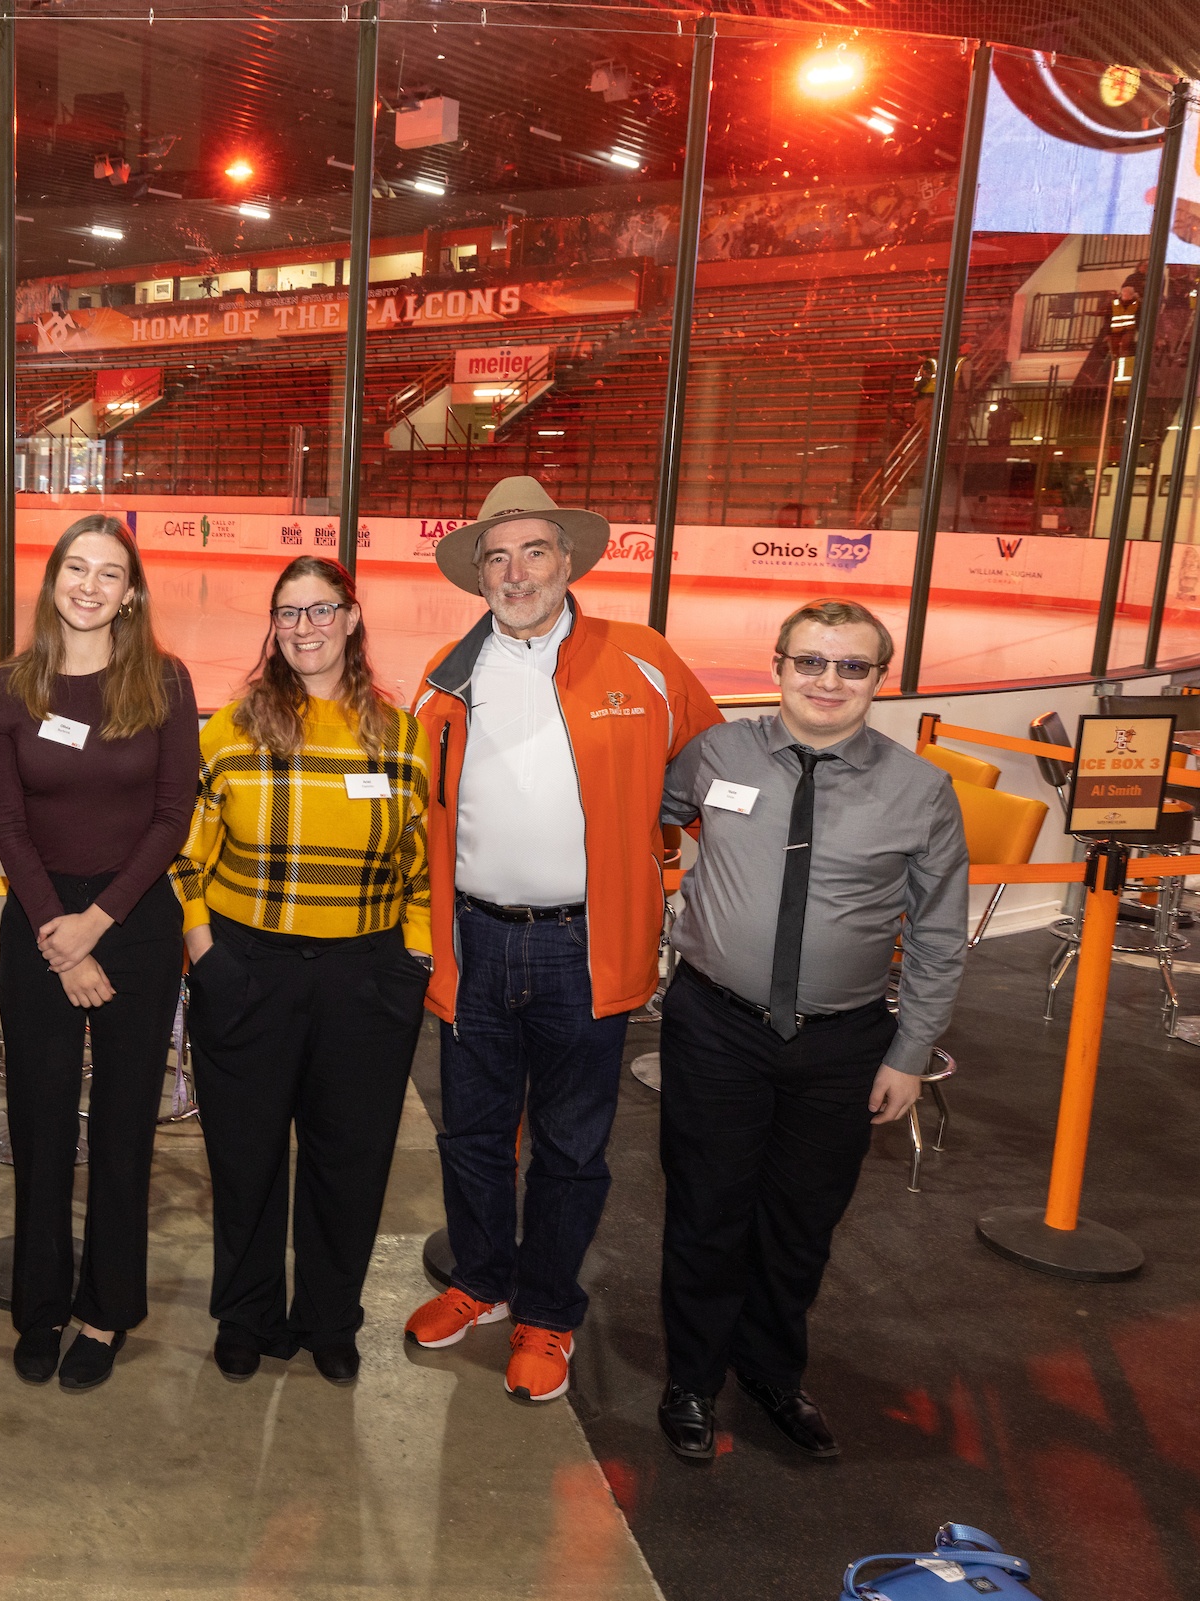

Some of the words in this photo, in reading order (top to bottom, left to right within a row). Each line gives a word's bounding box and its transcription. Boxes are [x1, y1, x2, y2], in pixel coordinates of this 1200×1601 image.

[219, 297, 261, 311] BOWLING
[265, 295, 298, 307] GREEN
[301, 292, 333, 304] STATE
[131, 313, 210, 342] HOME
[223, 309, 260, 335] OF
[274, 303, 341, 331] THE
[468, 350, 532, 378] meijer
[164, 520, 196, 536] CAFE
[281, 526, 302, 537] Blue
[315, 527, 336, 538] Blue
[357, 530, 370, 539] ue
[601, 540, 633, 560] Red
[752, 541, 818, 558] Ohio's
[828, 543, 869, 560] 529
[1079, 758, 1106, 770] ICE
[1110, 758, 1145, 770] BOX
[1148, 758, 1161, 770] 3
[1090, 785, 1105, 797] Al
[1107, 784, 1142, 796] Smith
